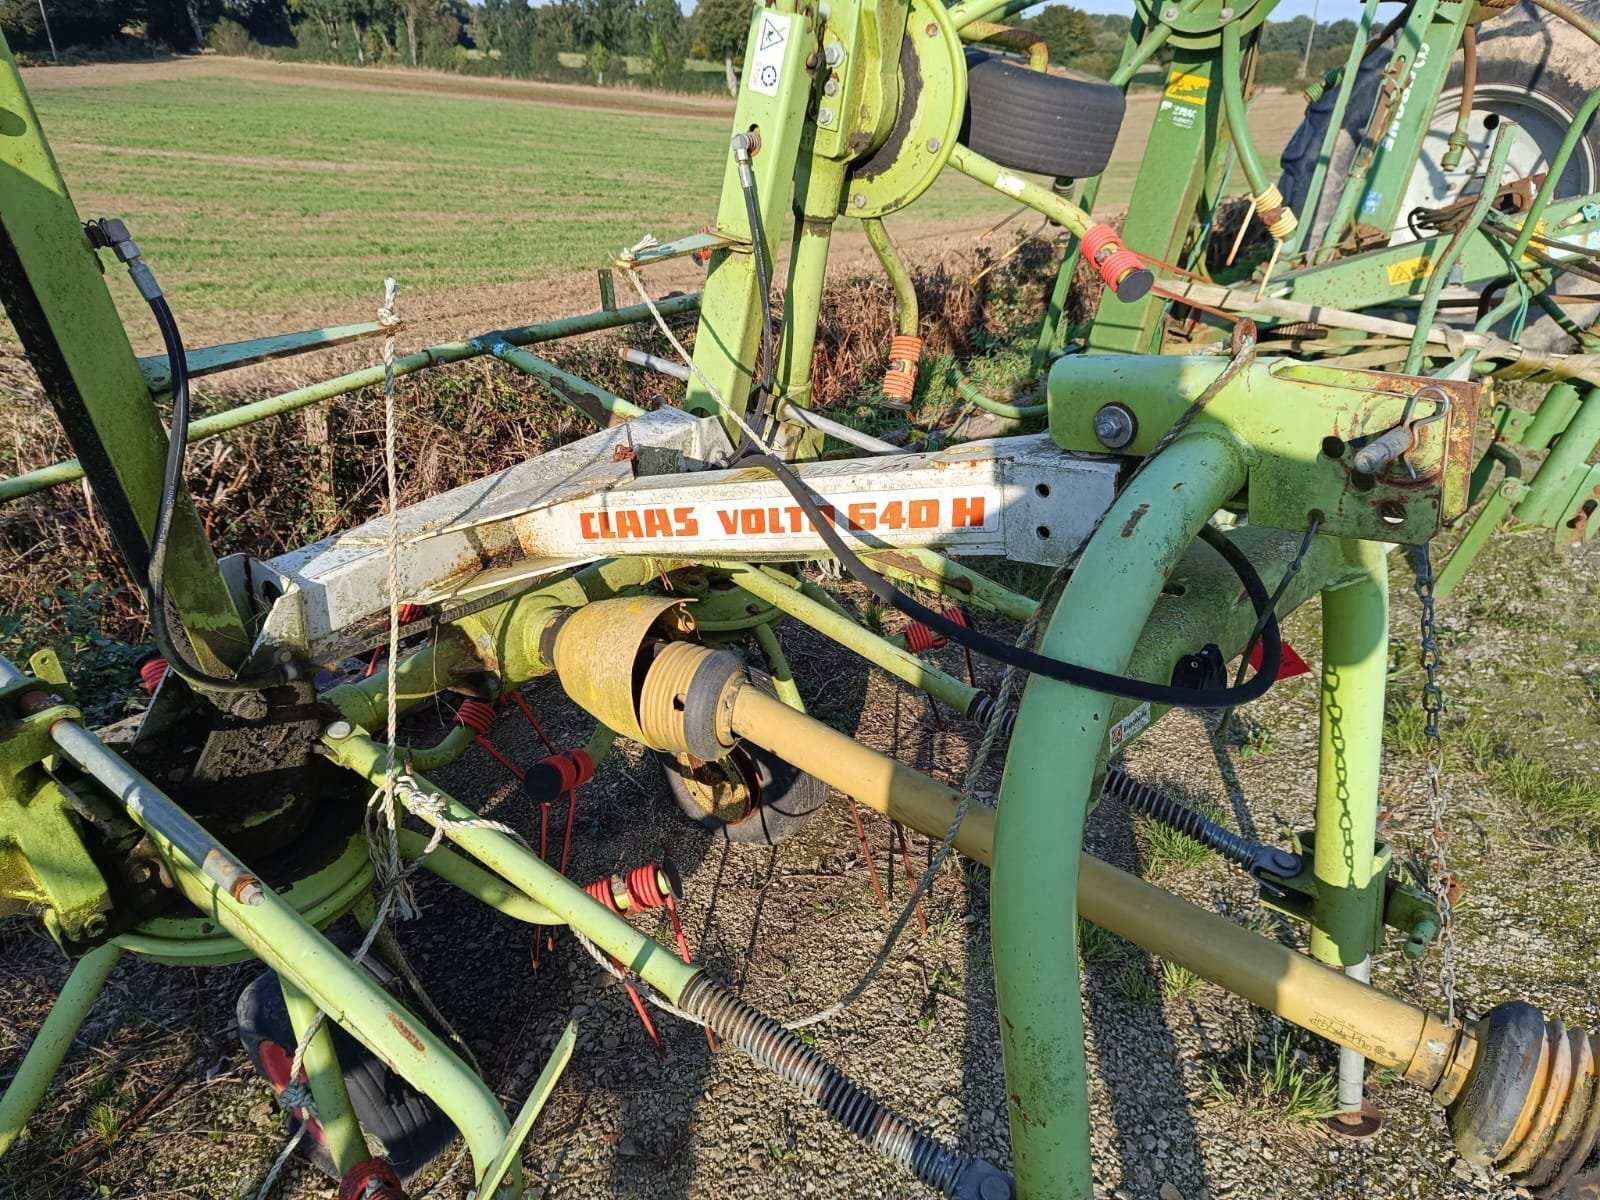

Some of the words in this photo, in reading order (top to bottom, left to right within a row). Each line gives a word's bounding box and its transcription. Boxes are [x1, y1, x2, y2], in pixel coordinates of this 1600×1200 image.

[580, 507, 698, 539] CLAAS
[849, 499, 940, 531] 640
[952, 497, 985, 527] H
